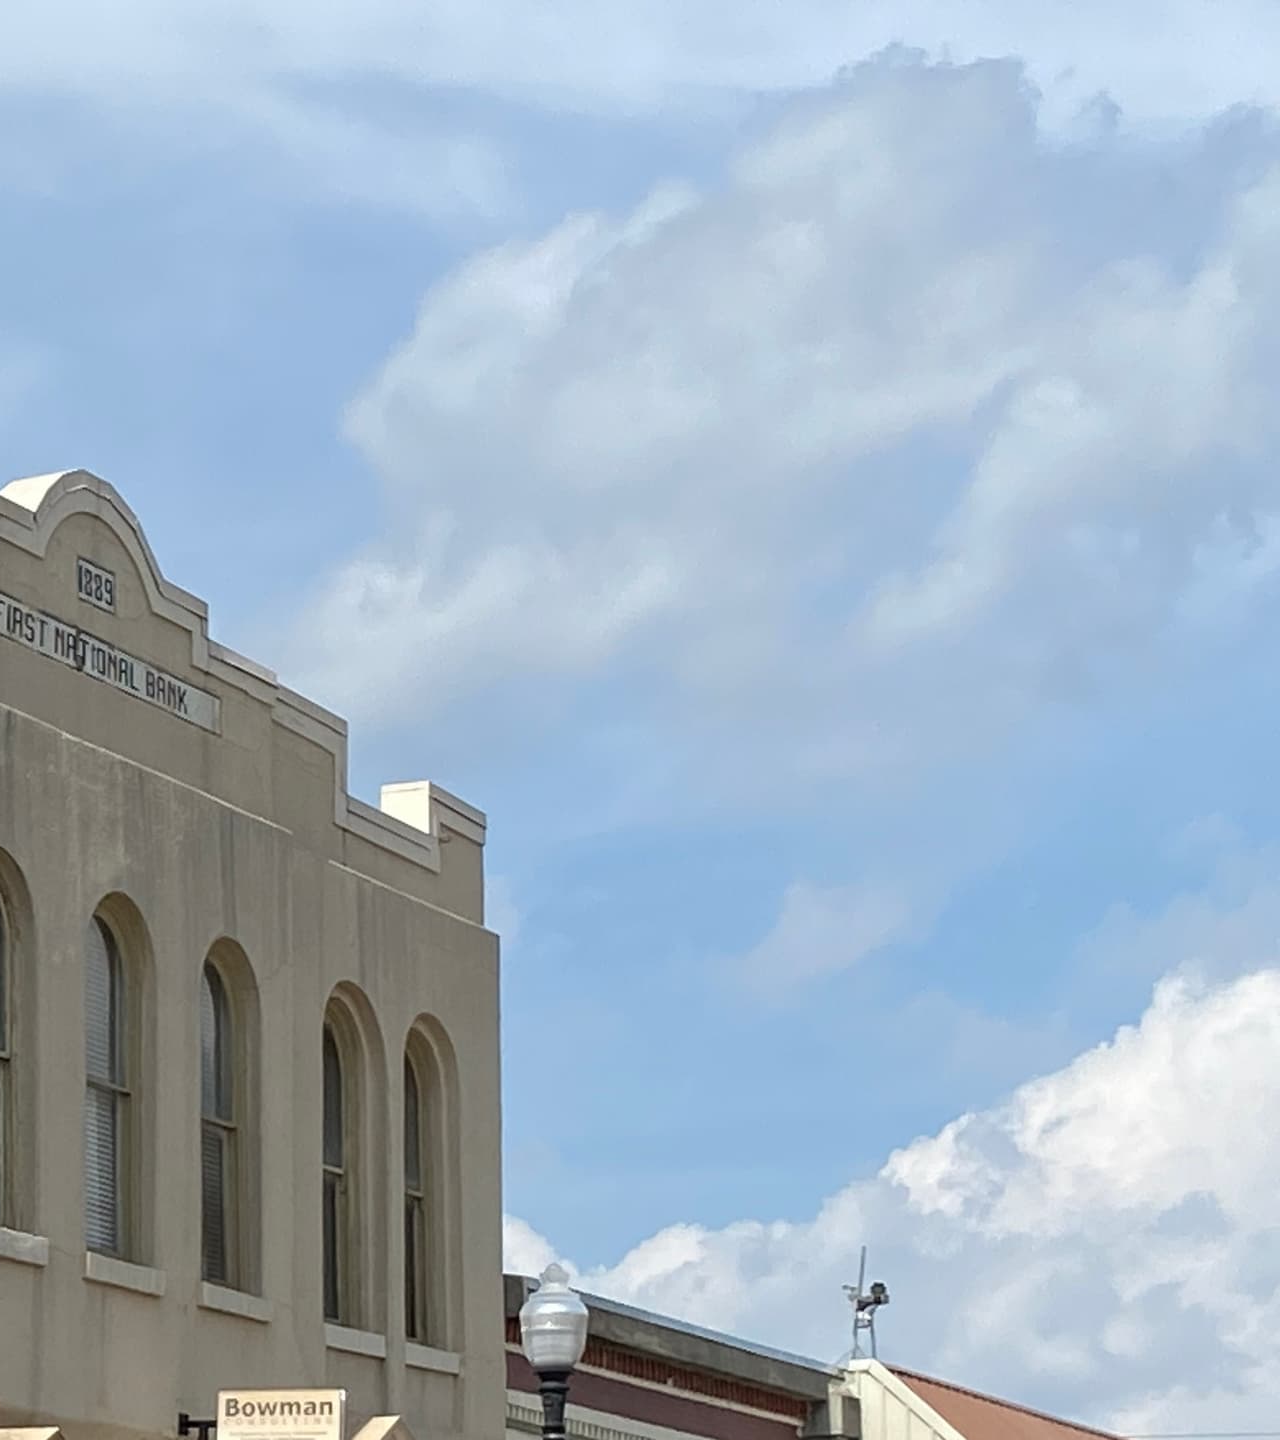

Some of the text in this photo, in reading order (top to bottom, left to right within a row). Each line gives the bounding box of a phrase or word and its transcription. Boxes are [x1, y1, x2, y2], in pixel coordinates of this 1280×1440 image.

[77, 564, 114, 606] 1889
[54, 627, 140, 691] NATIONAL
[145, 670, 188, 715] BANK
[225, 1398, 333, 1417] Bowman
